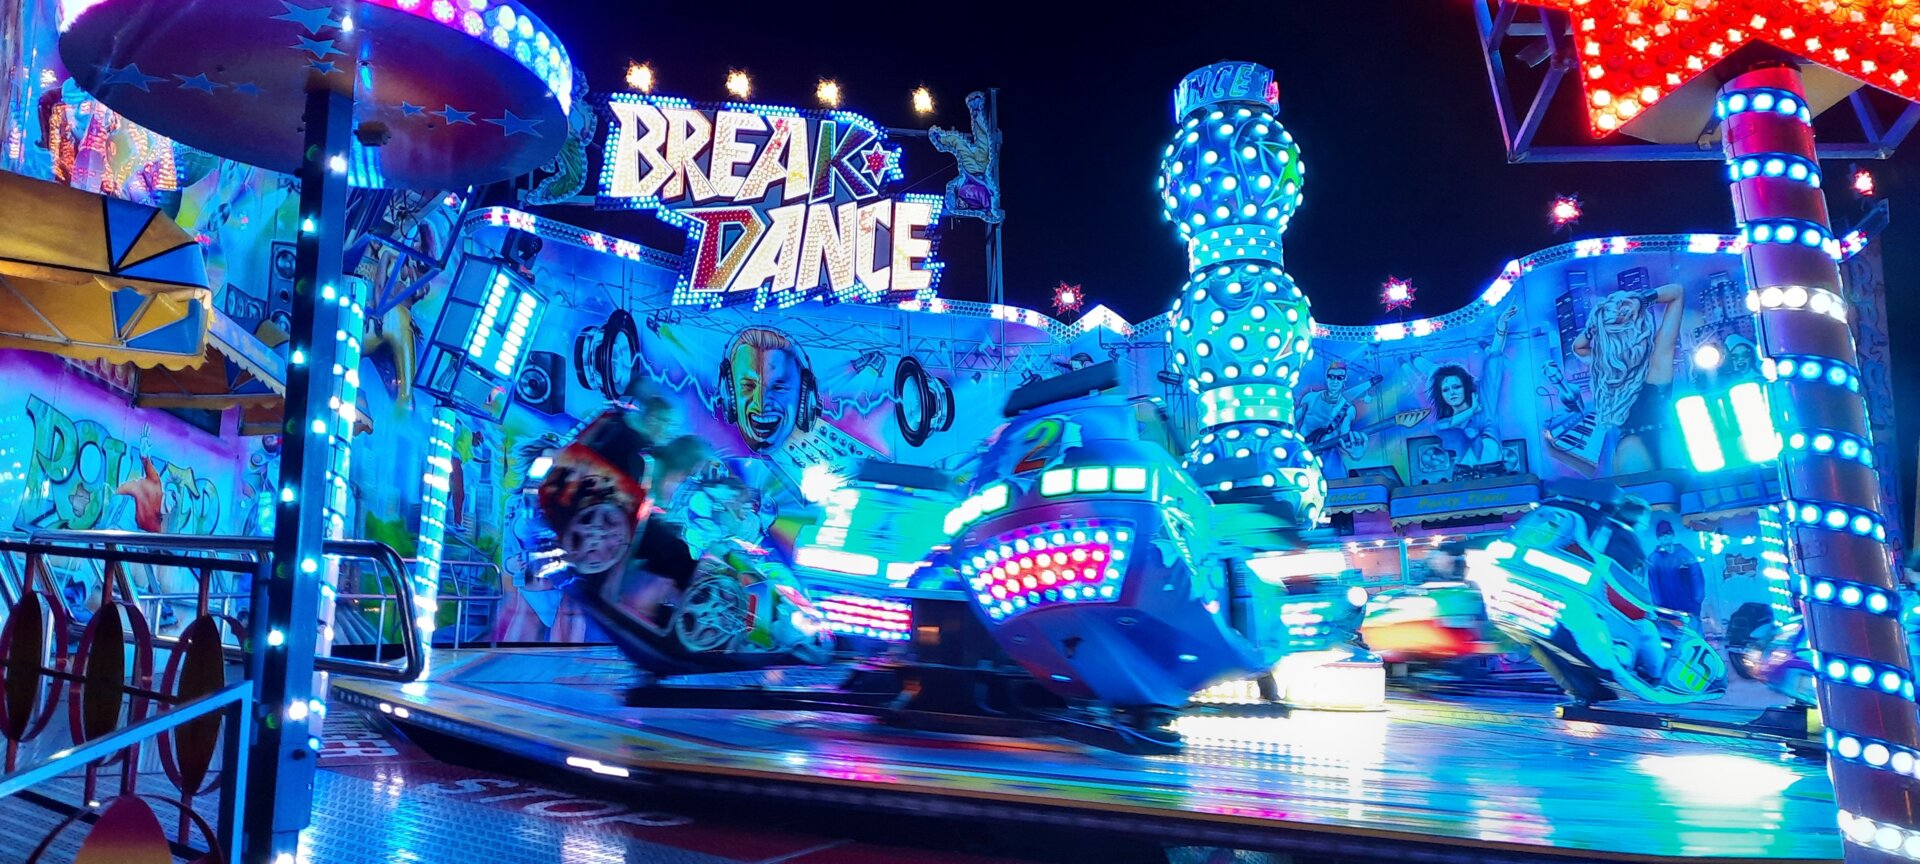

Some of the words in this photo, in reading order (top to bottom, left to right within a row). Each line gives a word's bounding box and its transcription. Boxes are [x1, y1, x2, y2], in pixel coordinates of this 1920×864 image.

[1178, 64, 1256, 106] NCE
[609, 102, 879, 204] BREAK
[679, 198, 933, 294] DANCE
[1012, 417, 1064, 475] 2
[1680, 645, 1712, 693] 15
[417, 777, 695, 827] STOP
